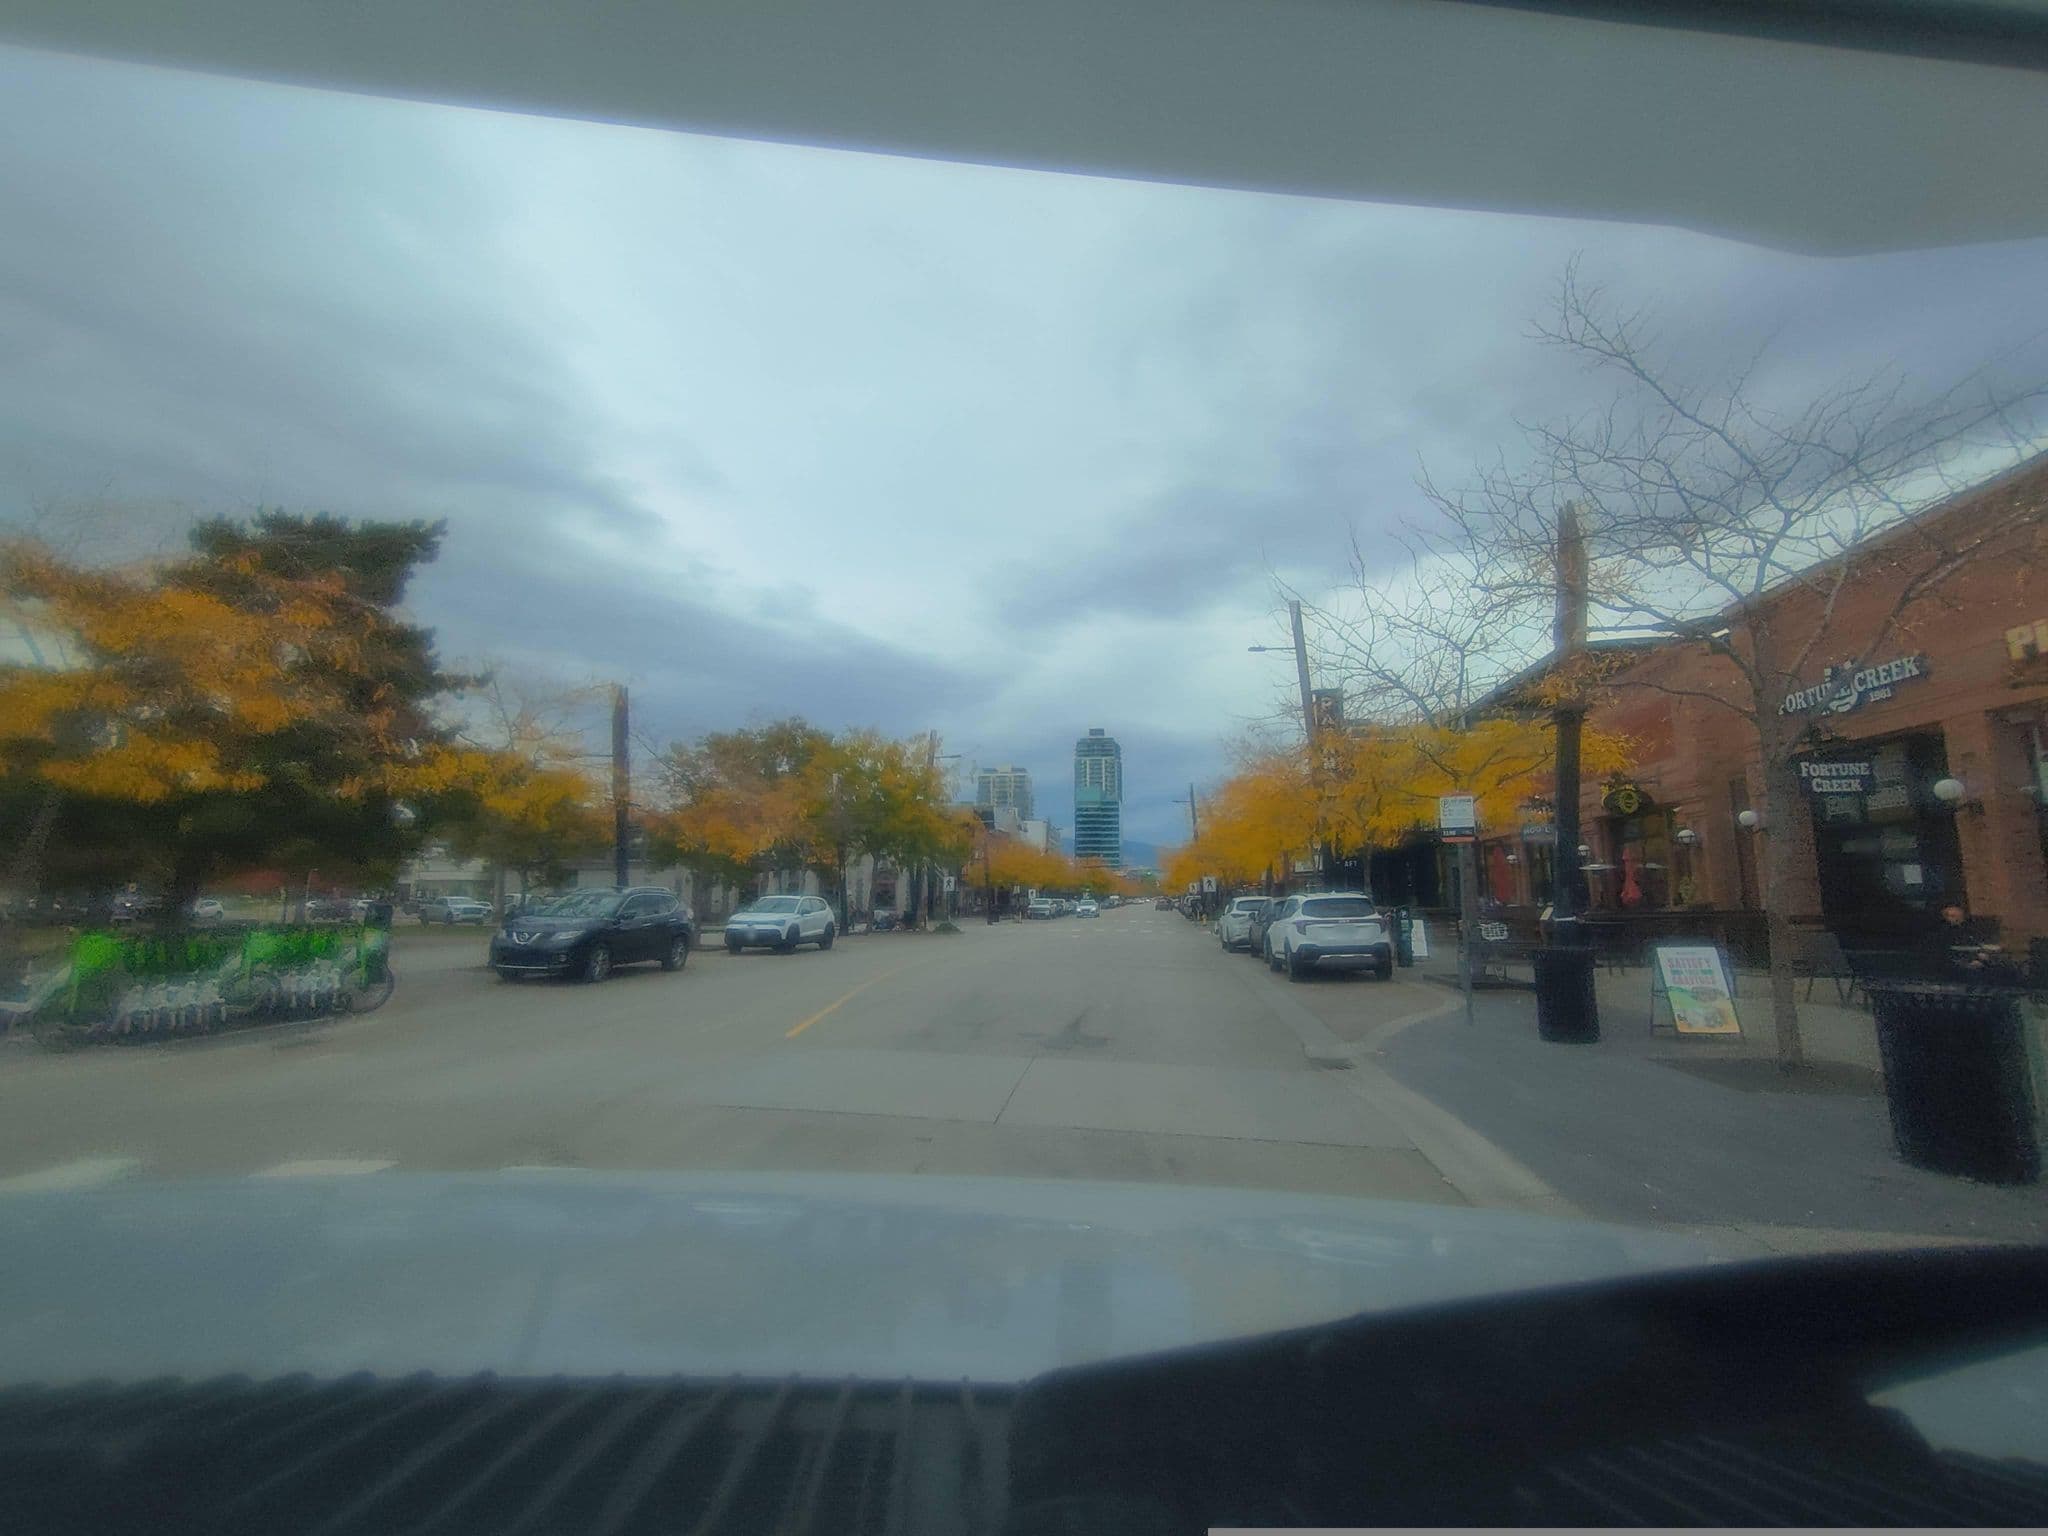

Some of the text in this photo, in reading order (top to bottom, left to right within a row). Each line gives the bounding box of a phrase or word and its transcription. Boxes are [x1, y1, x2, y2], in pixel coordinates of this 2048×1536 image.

[1853, 656, 1920, 693] CREEK
[1800, 762, 1870, 777] FORTUNE
[1811, 778, 1863, 792] CREEK
